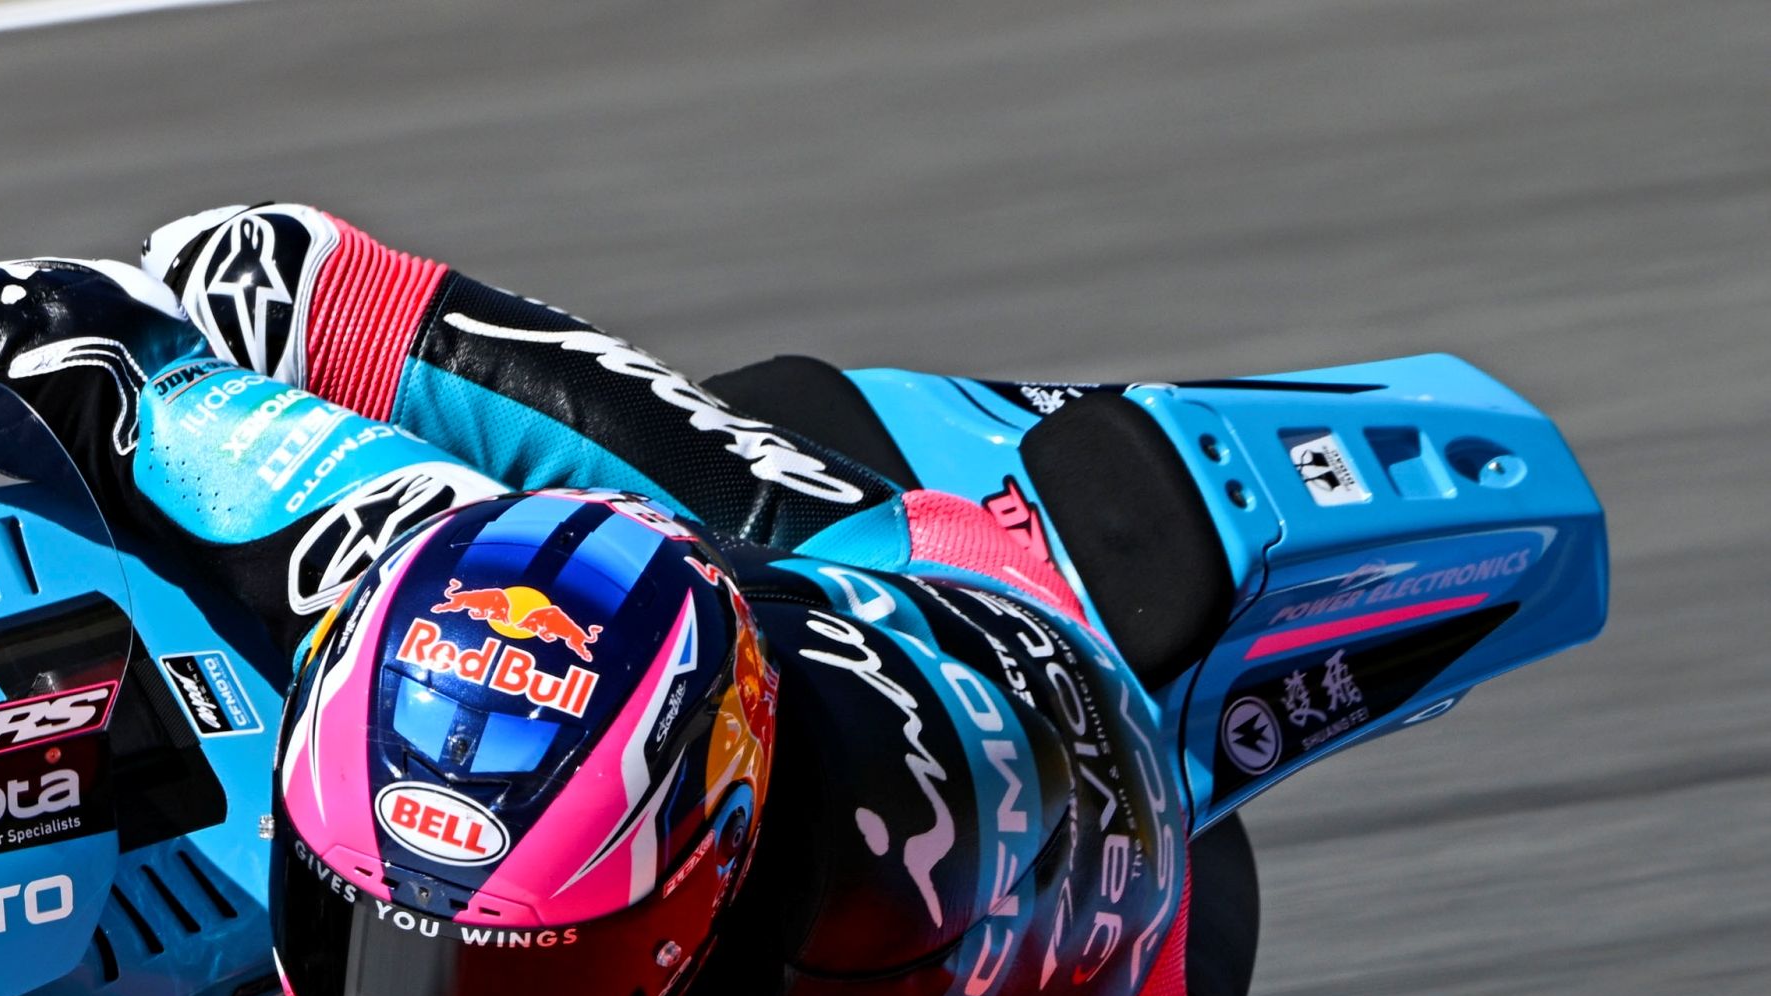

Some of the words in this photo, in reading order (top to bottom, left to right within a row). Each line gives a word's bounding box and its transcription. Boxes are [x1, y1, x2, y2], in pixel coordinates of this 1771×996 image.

[286, 426, 396, 513] CFMOTO
[1269, 591, 1360, 625] POWER
[1366, 549, 1530, 604] ELECTRONICS
[204, 658, 247, 726] CFMOTO
[397, 617, 490, 691] Red
[489, 639, 601, 719] Bull
[7, 814, 82, 844] Specialists
[389, 795, 489, 856] BELL
[294, 838, 356, 905] GIVES
[374, 899, 440, 939] YOU
[460, 926, 579, 949] WINGS
